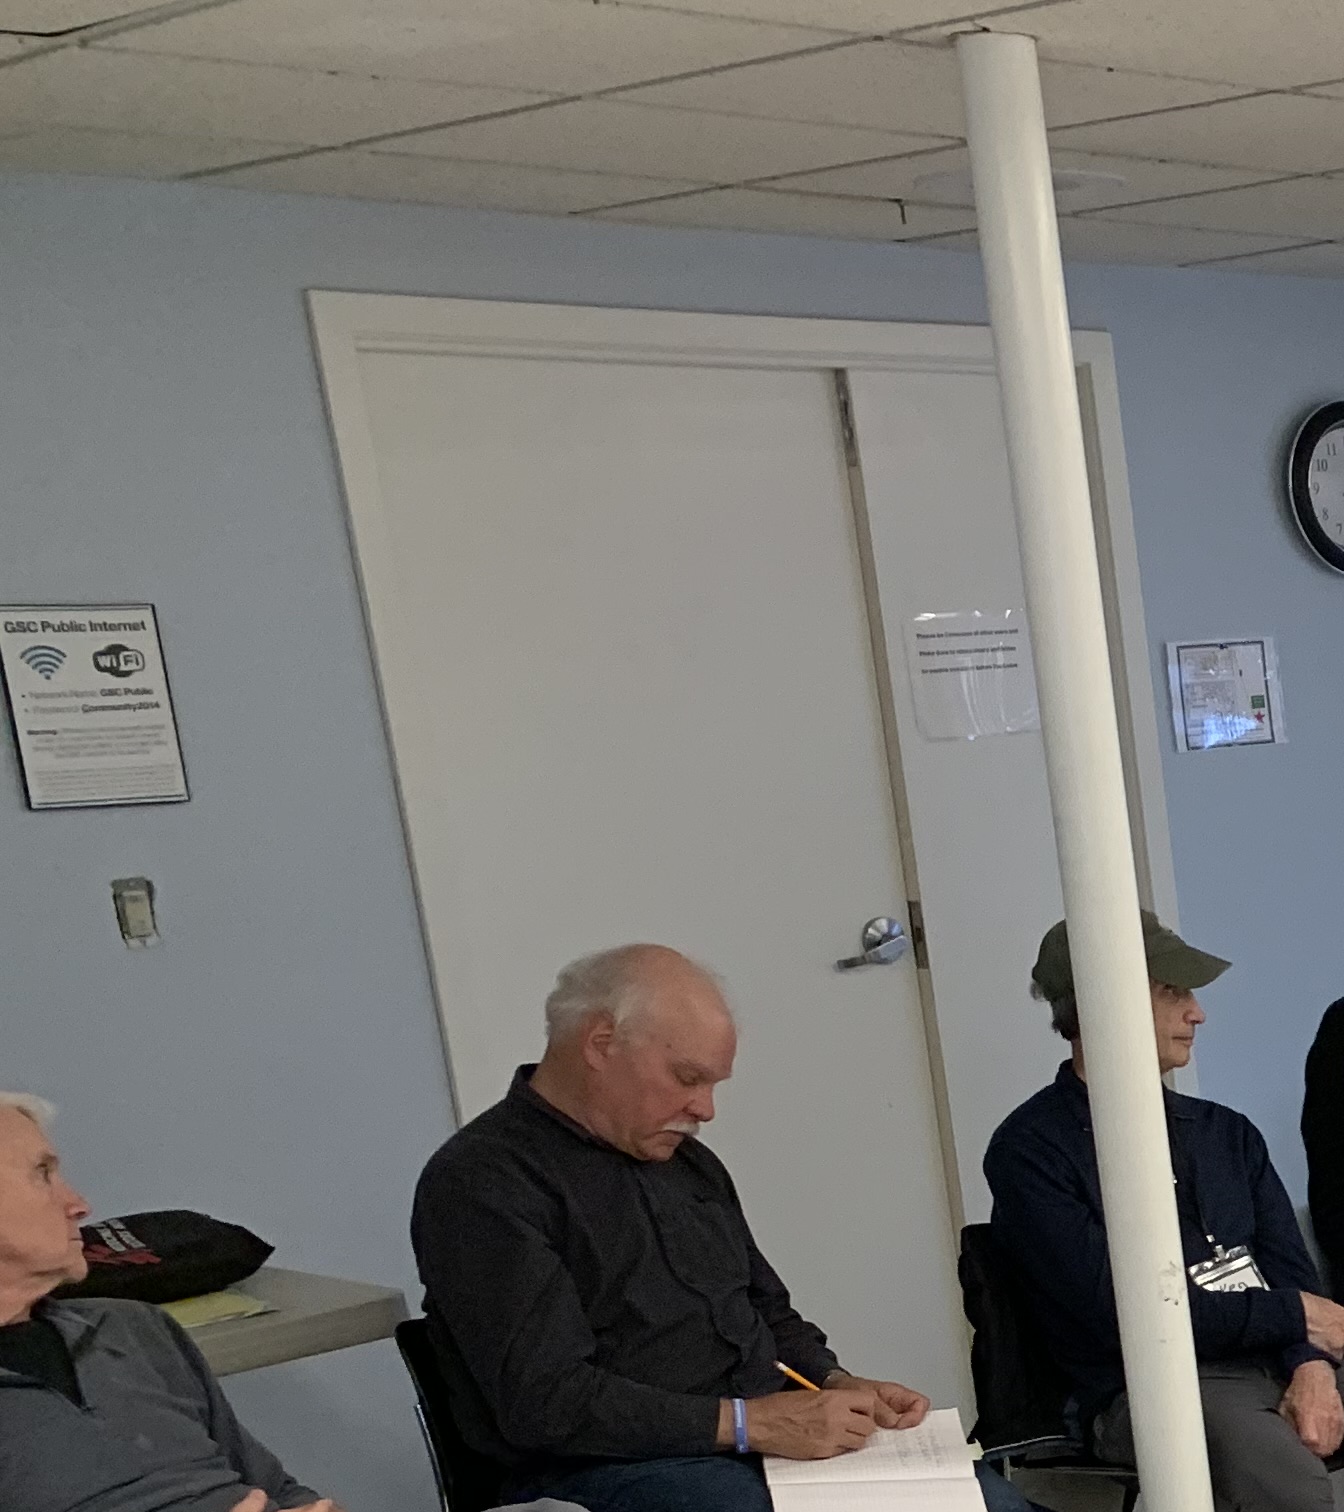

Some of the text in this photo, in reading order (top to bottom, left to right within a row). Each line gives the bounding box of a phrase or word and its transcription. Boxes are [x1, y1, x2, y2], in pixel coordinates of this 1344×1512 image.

[1326, 443, 1338, 456] 11
[1316, 458, 1328, 472] 10
[1312, 482, 1320, 495] 9
[1322, 507, 1329, 520] 8
[1335, 522, 1343, 534] 7
[4, 619, 147, 633] GSC Public Internet
